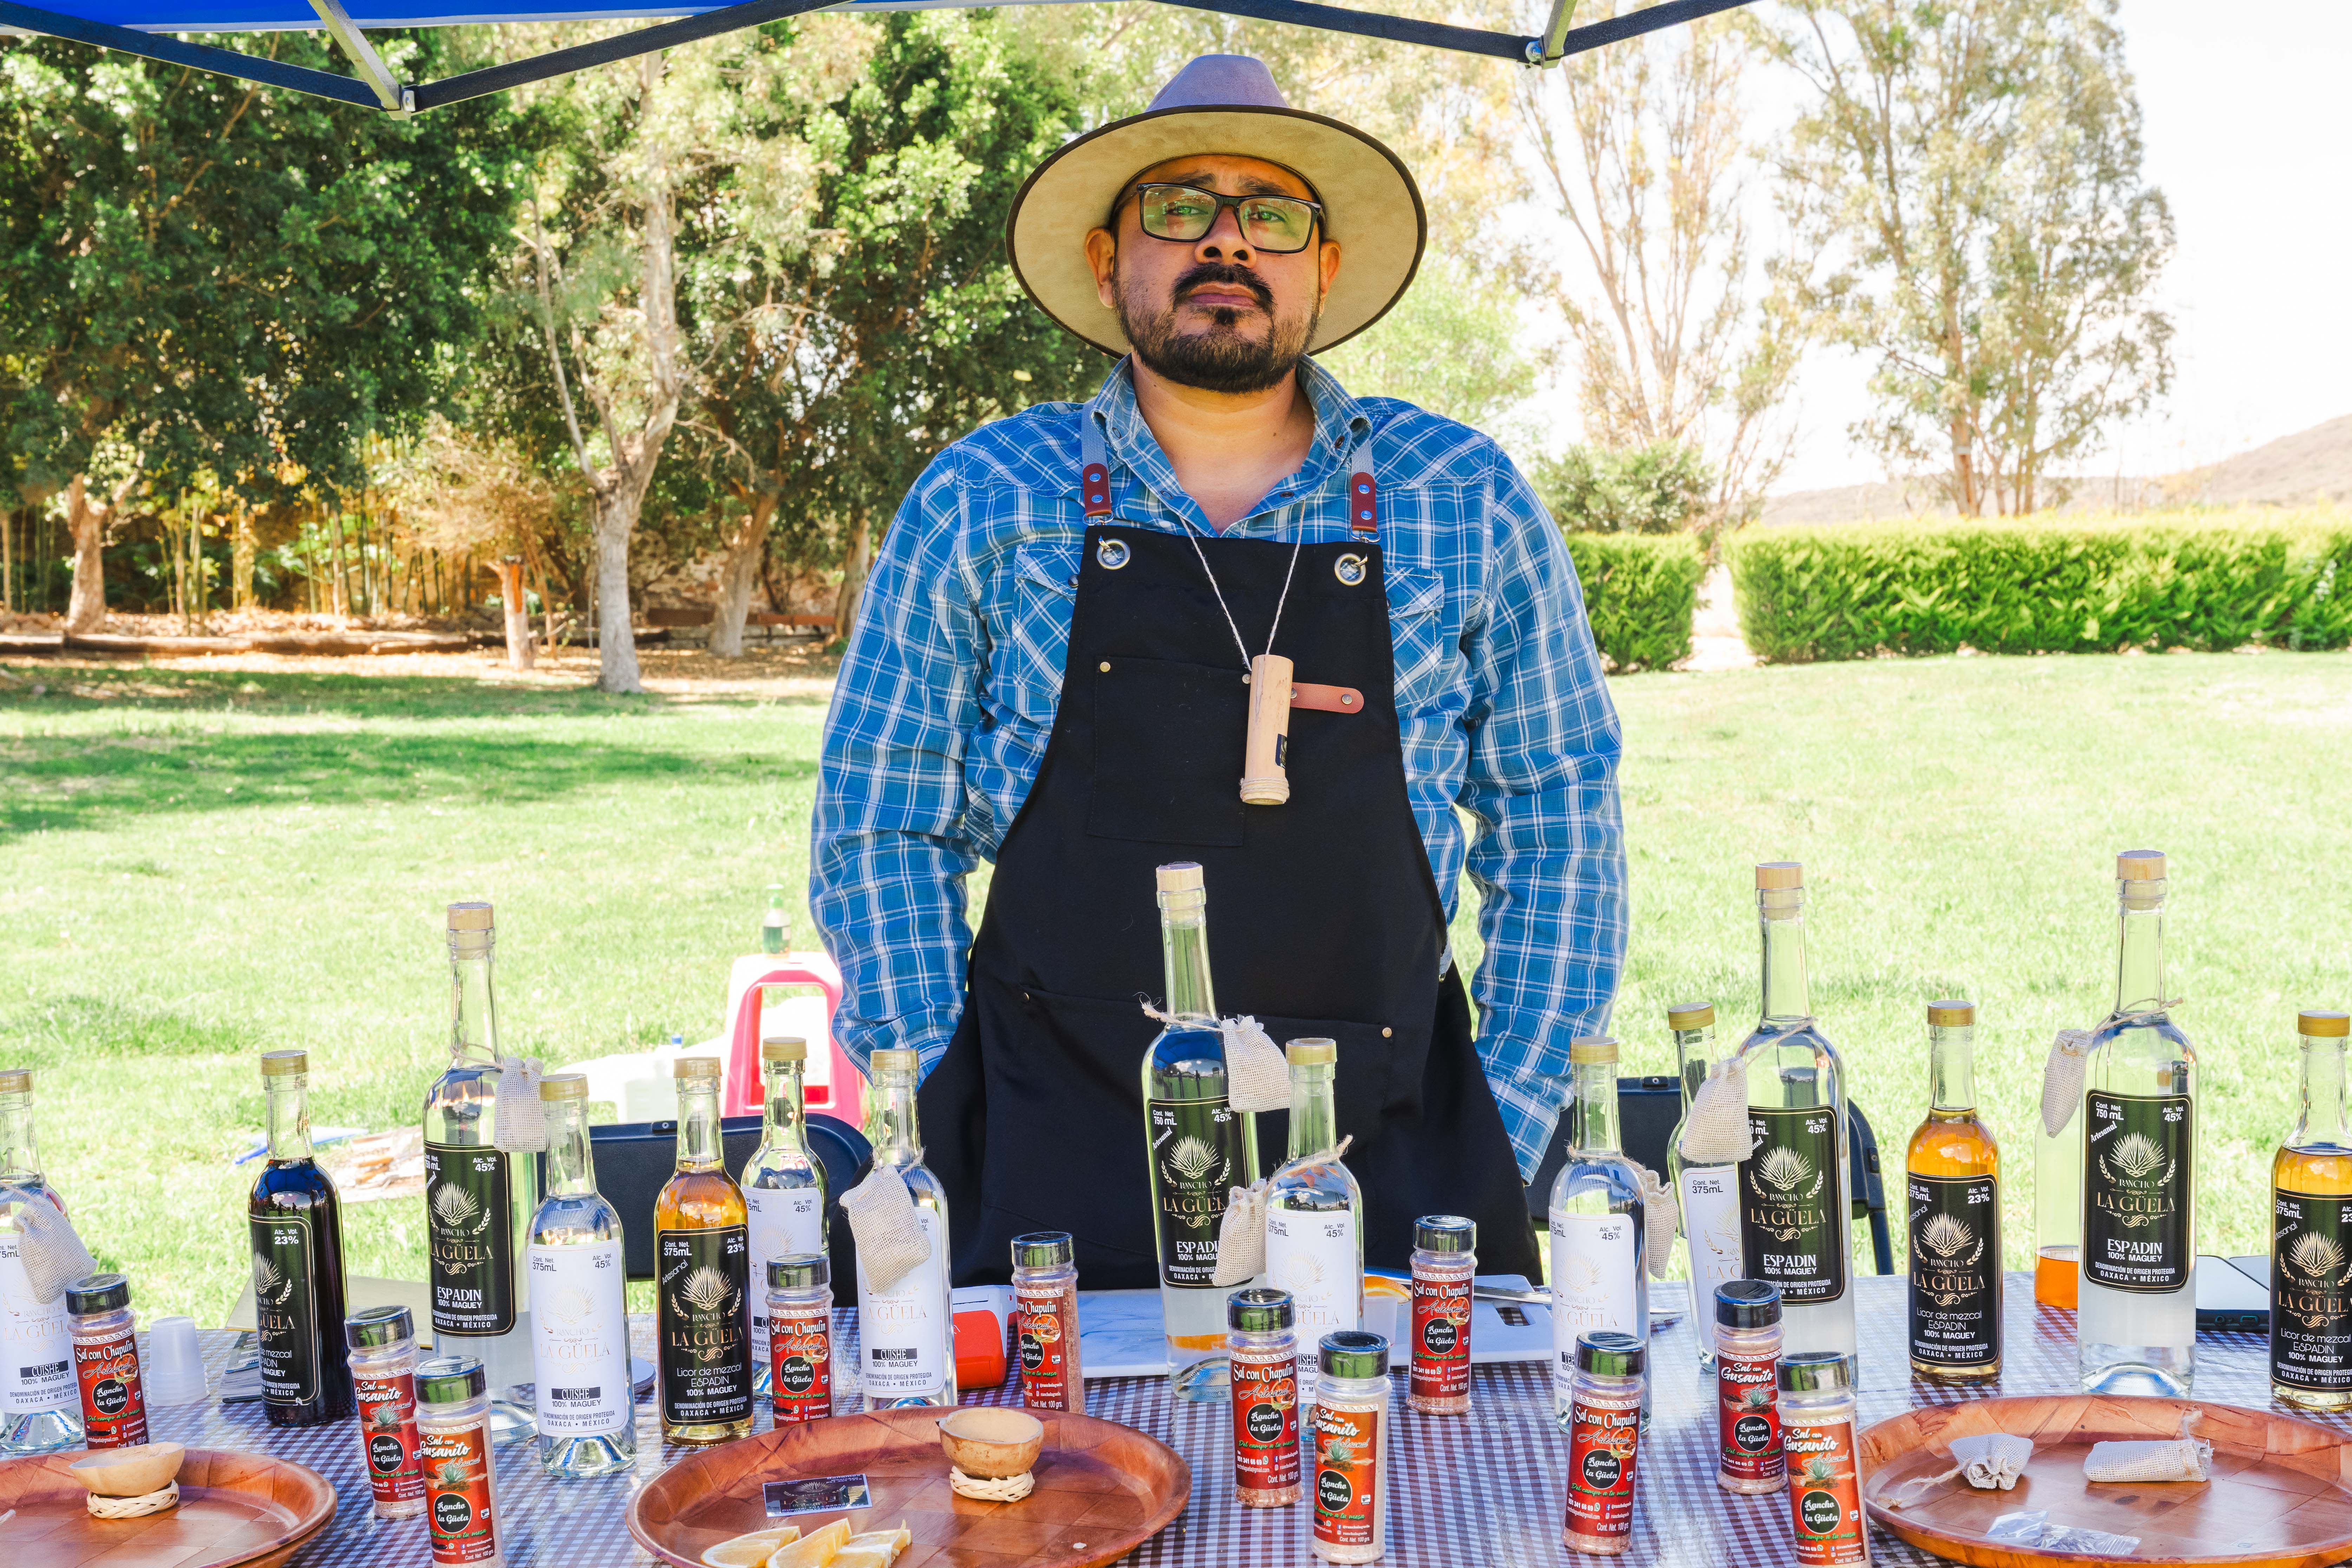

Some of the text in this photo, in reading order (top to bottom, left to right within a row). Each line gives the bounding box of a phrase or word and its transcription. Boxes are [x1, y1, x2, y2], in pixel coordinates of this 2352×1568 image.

[2096, 1101, 2108, 1109] Cont.
[2096, 1108, 2124, 1120] 750 mL
[2164, 1113, 2182, 1122] 45%
[1154, 1116, 1163, 1125] 750
[1808, 1125, 1826, 1134] 45%
[2091, 1121, 2117, 1143] Artesanal
[475, 1163, 495, 1171] 45%
[2119, 1178, 2154, 1188] RANCHO
[1968, 1194, 1990, 1204] 23%
[2097, 1193, 2175, 1212] LA GÜELA
[795, 1205, 811, 1213] 45%
[2276, 1205, 2302, 1219] 375mL
[1268, 1224, 1288, 1236] 375mL
[1327, 1229, 1343, 1237] 45%
[274, 1236, 299, 1244] 23%
[1602, 1232, 1620, 1240] 45%
[430, 1241, 493, 1260] LA GÜELA
[664, 1248, 692, 1256] 375mL
[727, 1243, 744, 1254] 23%
[2108, 1239, 2162, 1254] ESPADIN
[1764, 1254, 1816, 1267] ESPADIN
[533, 1262, 556, 1272] 375mL
[2095, 1262, 2125, 1272] DENOMINACIÓN
[1914, 1271, 1986, 1291] LA GÜELA
[2101, 1270, 2169, 1282] OAXACA MÉXICO
[437, 1286, 481, 1301] ESPADIN
[1415, 1281, 1424, 1297] Sal
[1425, 1287, 1438, 1296] con
[438, 1299, 450, 1307] 100%
[1917, 1307, 1981, 1319] Licor de mezcal
[771, 1320, 780, 1335] Sal
[782, 1324, 793, 1334] con
[1428, 1325, 1453, 1334] Rancho
[1929, 1320, 1966, 1330] ESPADIN
[672, 1327, 743, 1346] LA GÜELA
[2281, 1328, 2299, 1340] Licor
[2317, 1334, 2351, 1343] mezcal
[1436, 1337, 1455, 1346] Güela
[76, 1347, 86, 1363] Sal
[89, 1351, 102, 1360] con
[881, 1349, 907, 1360] CUISHE
[2288, 1351, 2305, 1360] 100%
[32, 1363, 59, 1377] CUISHE
[83, 1357, 132, 1379] Artesanal
[263, 1368, 286, 1377] MAGUEY
[677, 1363, 741, 1377] Licor de mezcal
[785, 1363, 810, 1373] Rancho
[1234, 1364, 1244, 1381] Sal
[1246, 1370, 1260, 1381] con
[1733, 1363, 1752, 1372] Sal
[792, 1376, 812, 1384] Güela
[1721, 1367, 1774, 1383] Gusanito
[361, 1381, 377, 1391] Sal
[691, 1376, 729, 1387] ESPADIN
[97, 1386, 123, 1397] Rancho
[562, 1387, 589, 1400] CUISHE
[686, 1385, 737, 1396] 100% MAGUEY
[1238, 1381, 1290, 1401] Artesanal
[16, 1389, 77, 1404] OAXACA MÉXICO
[106, 1396, 126, 1406] Güela
[720, 1404, 743, 1414] MÉXICO
[1251, 1412, 1279, 1422] Rancho
[1575, 1406, 1587, 1423] Sal
[1588, 1413, 1602, 1425] con
[1260, 1424, 1281, 1433] Güela
[1739, 1423, 1767, 1432] Rancho
[1792, 1428, 1811, 1440] Sal
[426, 1435, 443, 1445] Sal
[1747, 1436, 1769, 1444] Güela
[1784, 1435, 1839, 1453] Gusanito
[373, 1443, 398, 1452] Rancho
[420, 1440, 471, 1458] Gusanito
[381, 1455, 401, 1464] Güela
[1588, 1457, 1616, 1467] Rancho
[1595, 1470, 1617, 1480] Güela
[1321, 1477, 1347, 1489] Rancho
[1320, 1489, 1326, 1498] la
[1327, 1491, 1349, 1502] Güela
[438, 1502, 465, 1512] Rancho
[1805, 1500, 1835, 1511] Rancho
[438, 1514, 469, 1524] la Güela
[1805, 1513, 1838, 1524] la Güela
